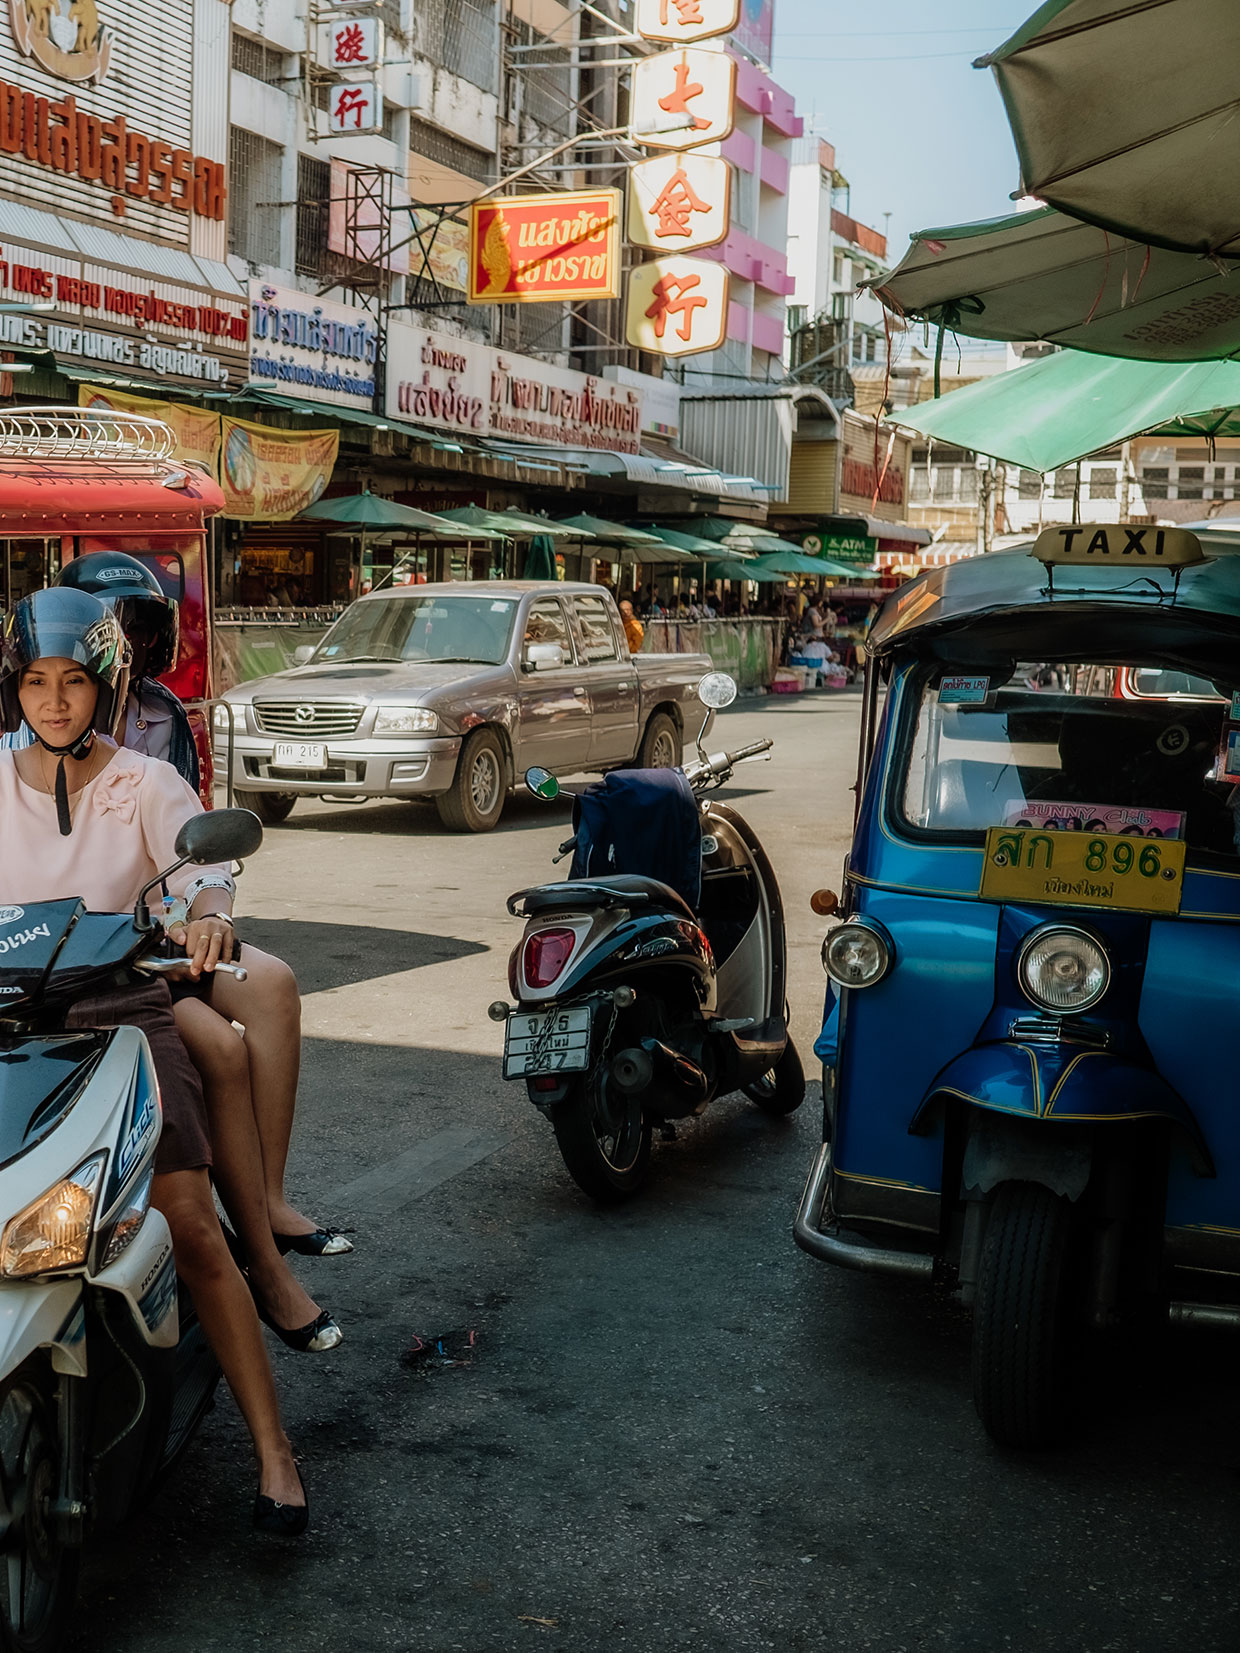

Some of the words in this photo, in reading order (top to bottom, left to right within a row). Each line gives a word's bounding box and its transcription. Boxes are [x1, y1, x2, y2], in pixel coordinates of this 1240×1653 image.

[518, 210, 608, 248] แสงชัย
[13, 264, 54, 298] เพชร
[57, 274, 101, 309] พลอย
[841, 539, 865, 550] ATM
[1057, 529, 1166, 556] TAXI
[300, 745, 319, 757] 215
[1021, 804, 1096, 821] BUNNY
[1084, 838, 1162, 879] 896
[543, 914, 573, 923] HONDA
[140, 1244, 171, 1292] HONDA
